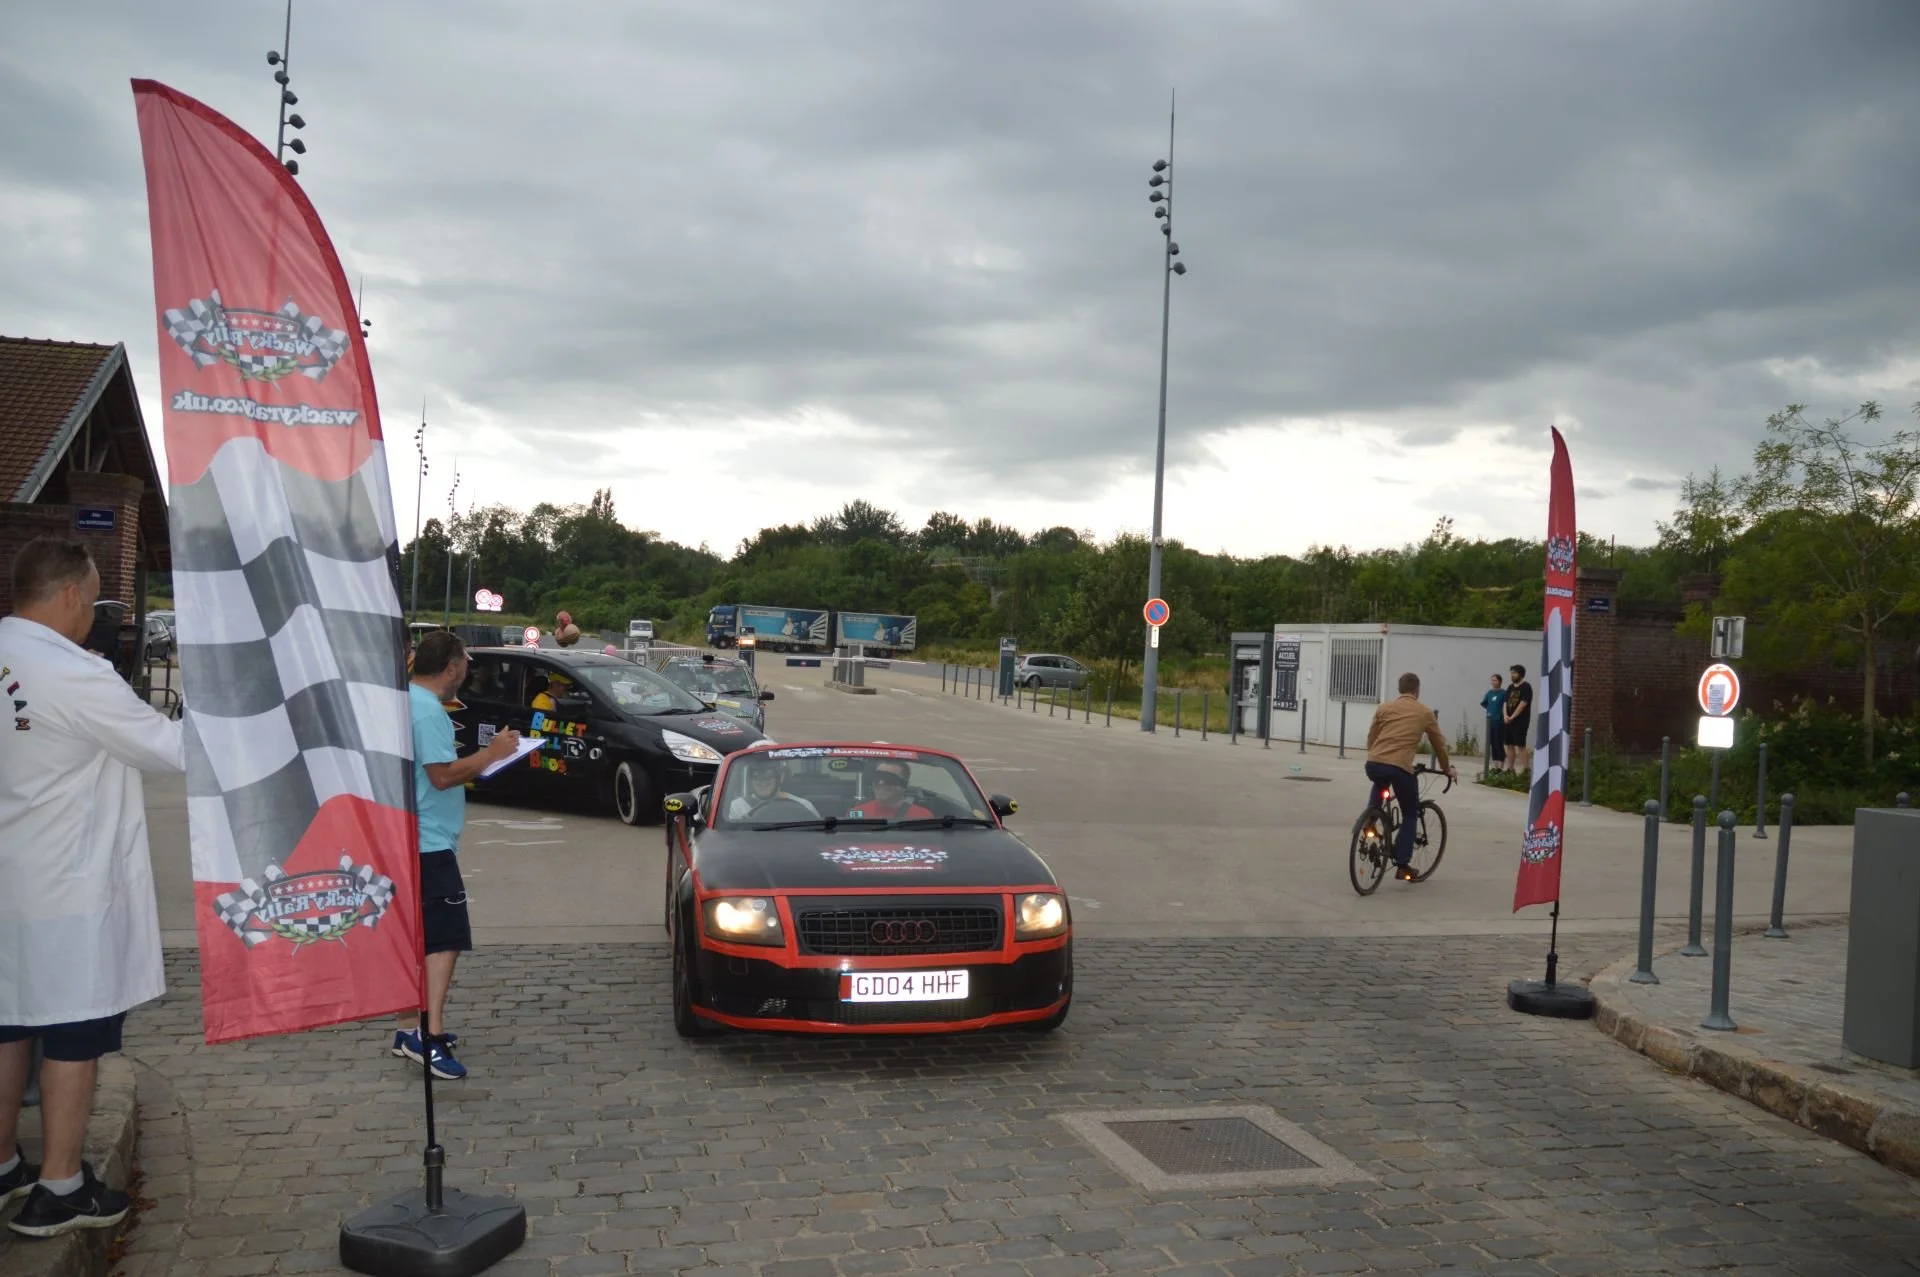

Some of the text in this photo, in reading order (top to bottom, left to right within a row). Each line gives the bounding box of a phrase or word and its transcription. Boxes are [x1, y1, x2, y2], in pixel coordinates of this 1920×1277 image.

[531, 711, 587, 737] BULLET
[856, 974, 963, 996] GD04 HHF
